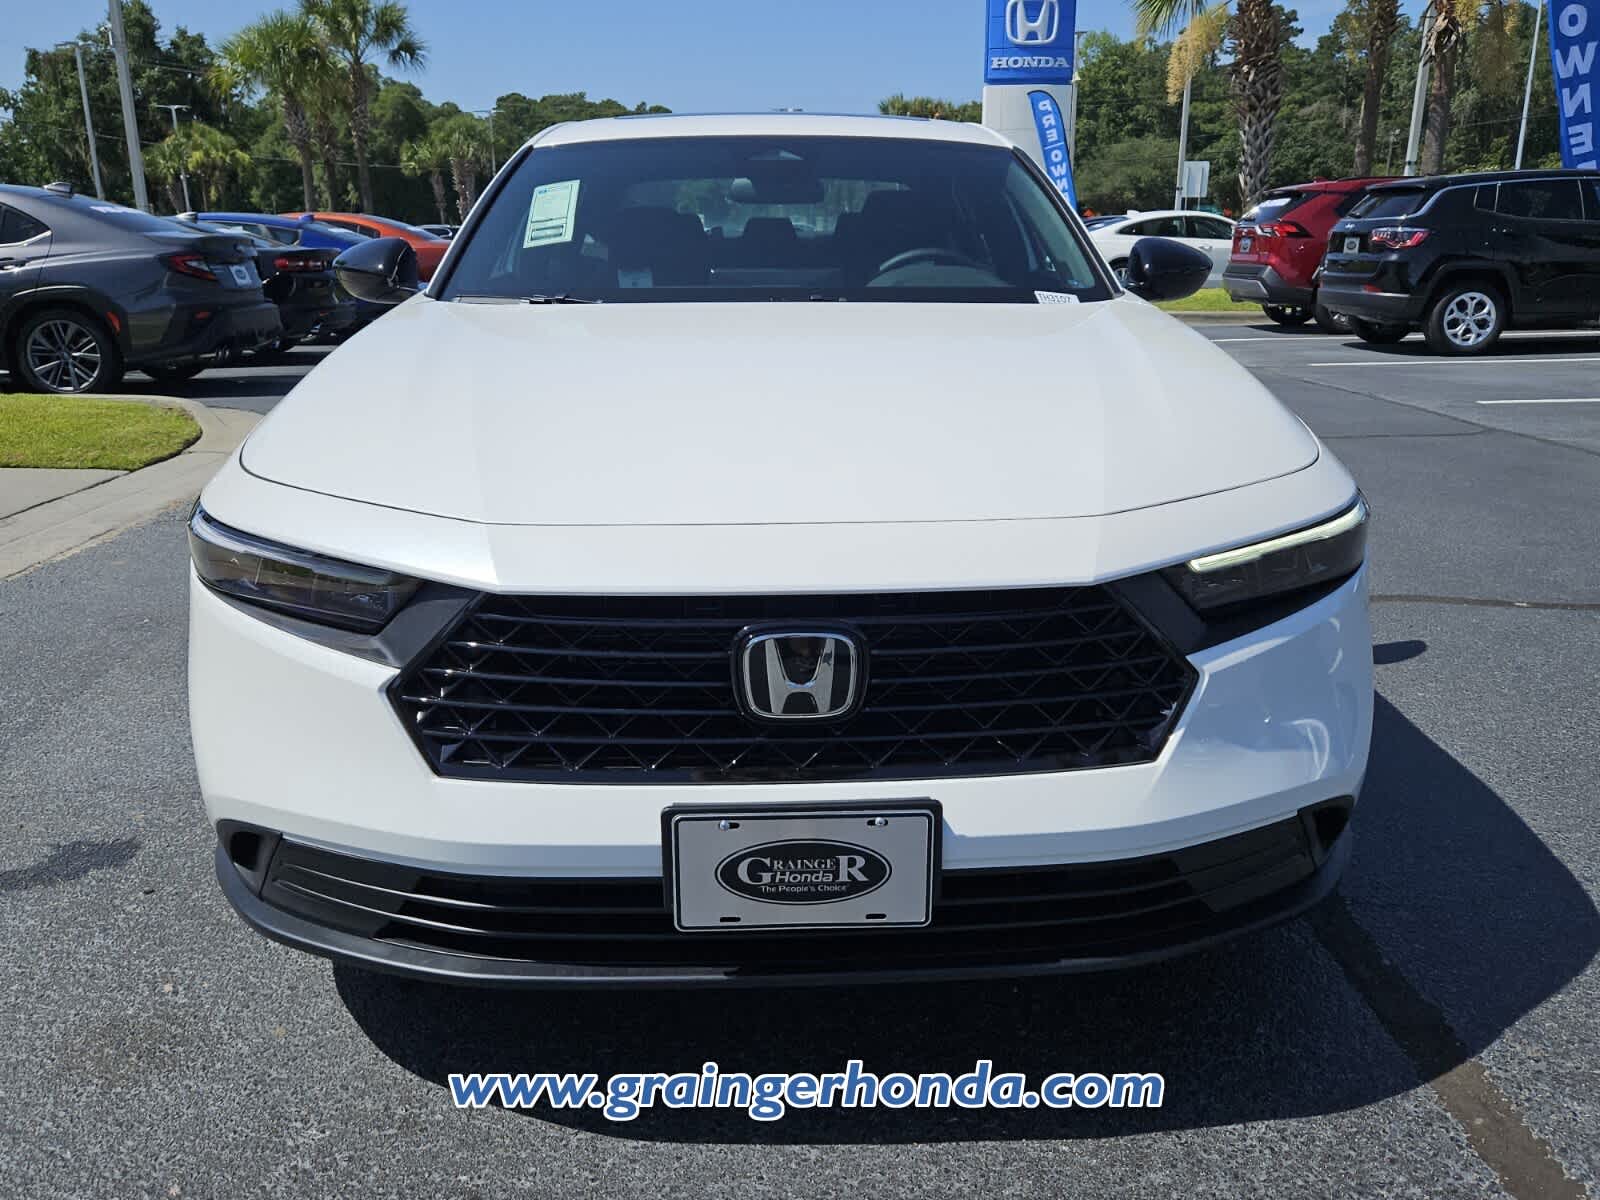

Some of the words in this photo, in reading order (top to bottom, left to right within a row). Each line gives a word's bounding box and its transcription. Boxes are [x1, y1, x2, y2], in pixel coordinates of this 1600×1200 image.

[991, 56, 1070, 69] HONDA
[736, 854, 870, 885] GRAINGER
[775, 870, 834, 883] Honda
[760, 885, 776, 893] The
[778, 885, 816, 894] People's
[817, 884, 847, 892] Choice
